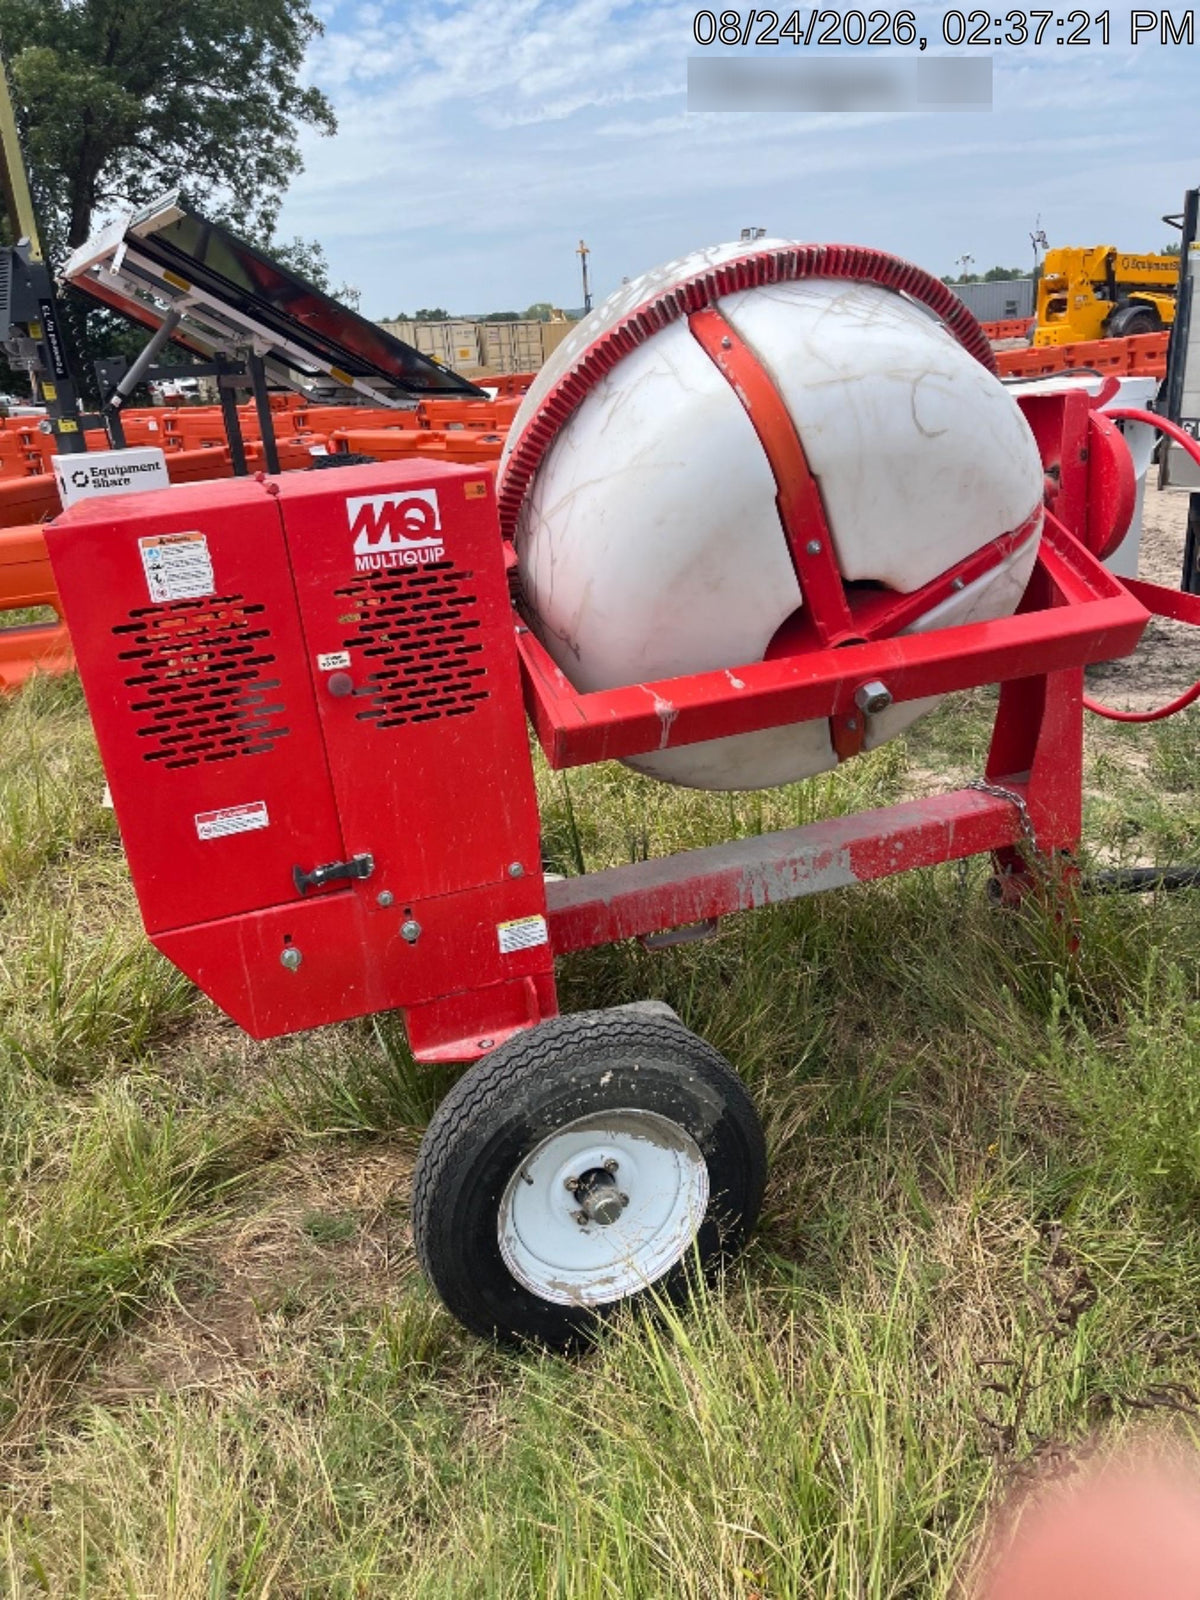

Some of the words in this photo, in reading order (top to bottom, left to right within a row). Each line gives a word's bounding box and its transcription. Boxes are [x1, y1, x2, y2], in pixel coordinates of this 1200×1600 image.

[90, 461, 161, 478] Equipment
[92, 477, 131, 488] Share
[349, 497, 443, 545] MQ
[355, 547, 445, 572] MULTIQUIP
